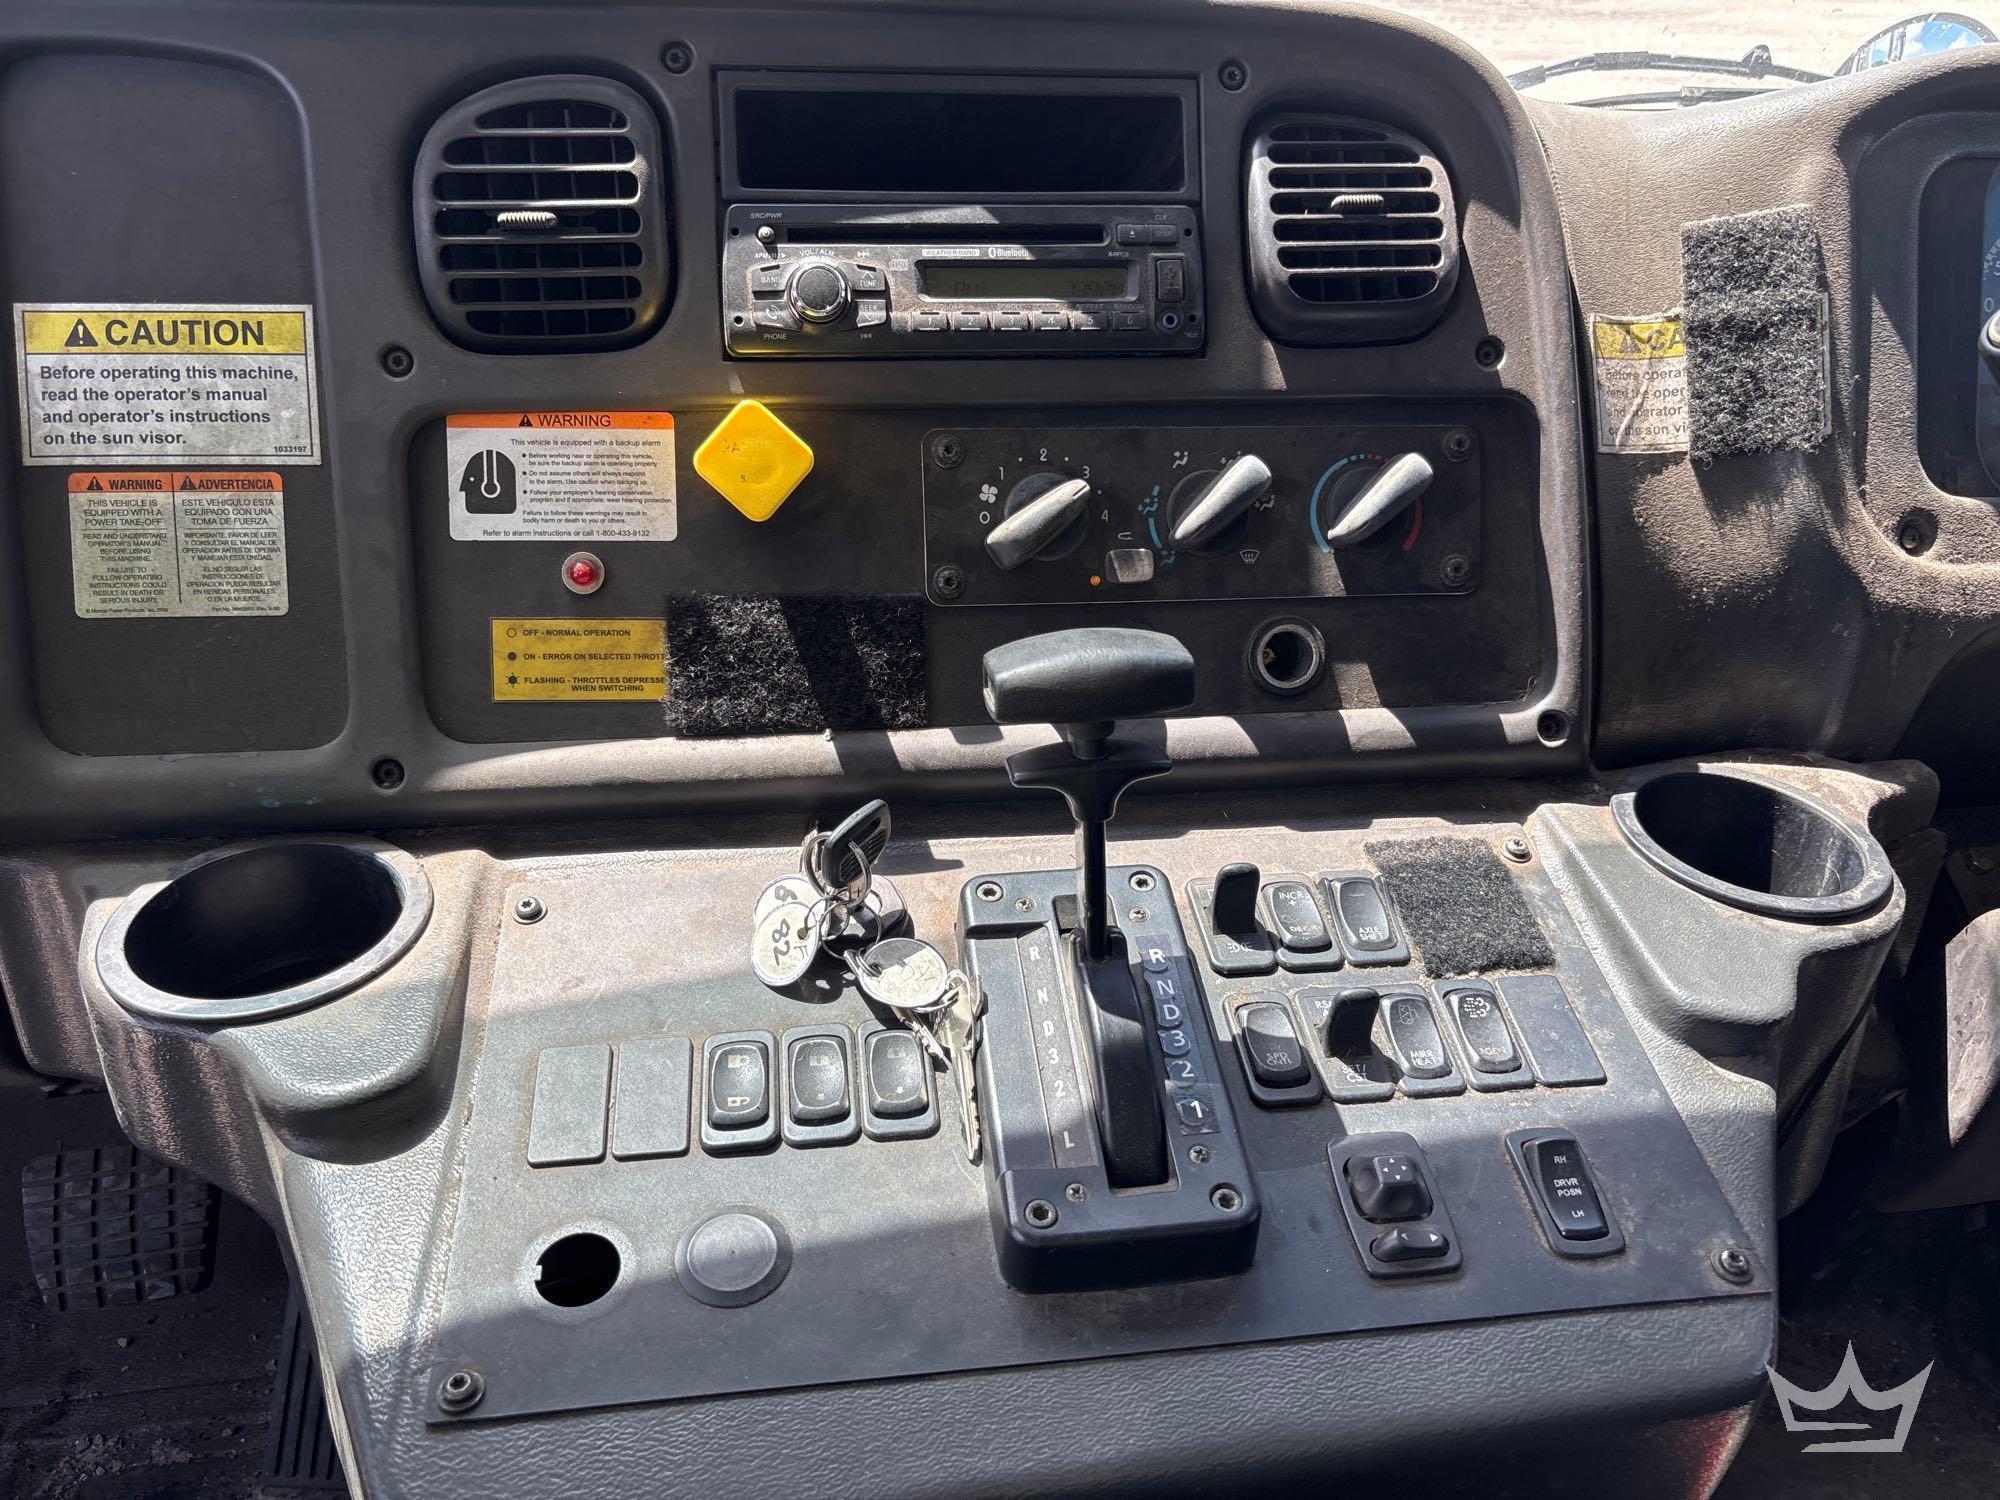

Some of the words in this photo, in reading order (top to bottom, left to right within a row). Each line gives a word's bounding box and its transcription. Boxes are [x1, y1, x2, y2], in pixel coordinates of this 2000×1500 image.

[968, 318, 974, 326] 2
[1088, 316, 1094, 324] 5
[105, 319, 264, 346] CAUTION
[1648, 328, 1684, 351] CA
[41, 366, 95, 380] Before
[101, 365, 181, 382] operating
[186, 365, 217, 379] this
[223, 366, 298, 382] machine,
[1643, 369, 1685, 381] opera
[42, 388, 78, 401] read
[84, 388, 109, 401] the
[115, 388, 200, 403] operator's
[206, 387, 267, 401] manual
[43, 410, 73, 423] and
[79, 410, 164, 425] operator's
[170, 409, 270, 423] instructions
[538, 415, 611, 427] WARNING
[1646, 426, 1669, 436] sun
[44, 433, 64, 445] on
[70, 432, 96, 445] the
[102, 433, 134, 445] sun
[139, 431, 186, 444] visor.
[560, 439, 592, 448] equipped
[616, 439, 640, 448] backup
[1040, 448, 1048, 461] 2
[999, 466, 1004, 480] 1
[1083, 466, 1090, 479] 3
[109, 480, 162, 490] WARNING
[198, 480, 274, 489] ADVERTENCIA
[84, 509, 128, 517] EQUIPPED
[979, 511, 991, 524] 0
[1101, 510, 1109, 523] 4
[1279, 891, 1304, 899] INCR
[1030, 946, 1041, 962] R
[1149, 949, 1166, 964] R
[1158, 980, 1174, 996] N
[1037, 989, 1049, 1005] N
[1164, 1005, 1180, 1020] D
[1043, 1020, 1054, 1037] D
[1171, 1030, 1186, 1047] 3
[1049, 1048, 1059, 1065] 3
[1267, 1052, 1288, 1060] SPD
[1410, 1050, 1433, 1058] MIRR
[1267, 1058, 1294, 1066] CNTL
[1412, 1058, 1436, 1066] HEAT
[1180, 1060, 1194, 1078] 2
[1347, 1073, 1367, 1082] CST
[1054, 1080, 1066, 1098] 2
[1190, 1101, 1203, 1119] 1
[1064, 1131, 1075, 1149] L
[1553, 1156, 1567, 1164] RH
[1554, 1177, 1579, 1187] DRVR
[1558, 1187, 1582, 1197] POSN
[1571, 1209, 1585, 1218] LH
